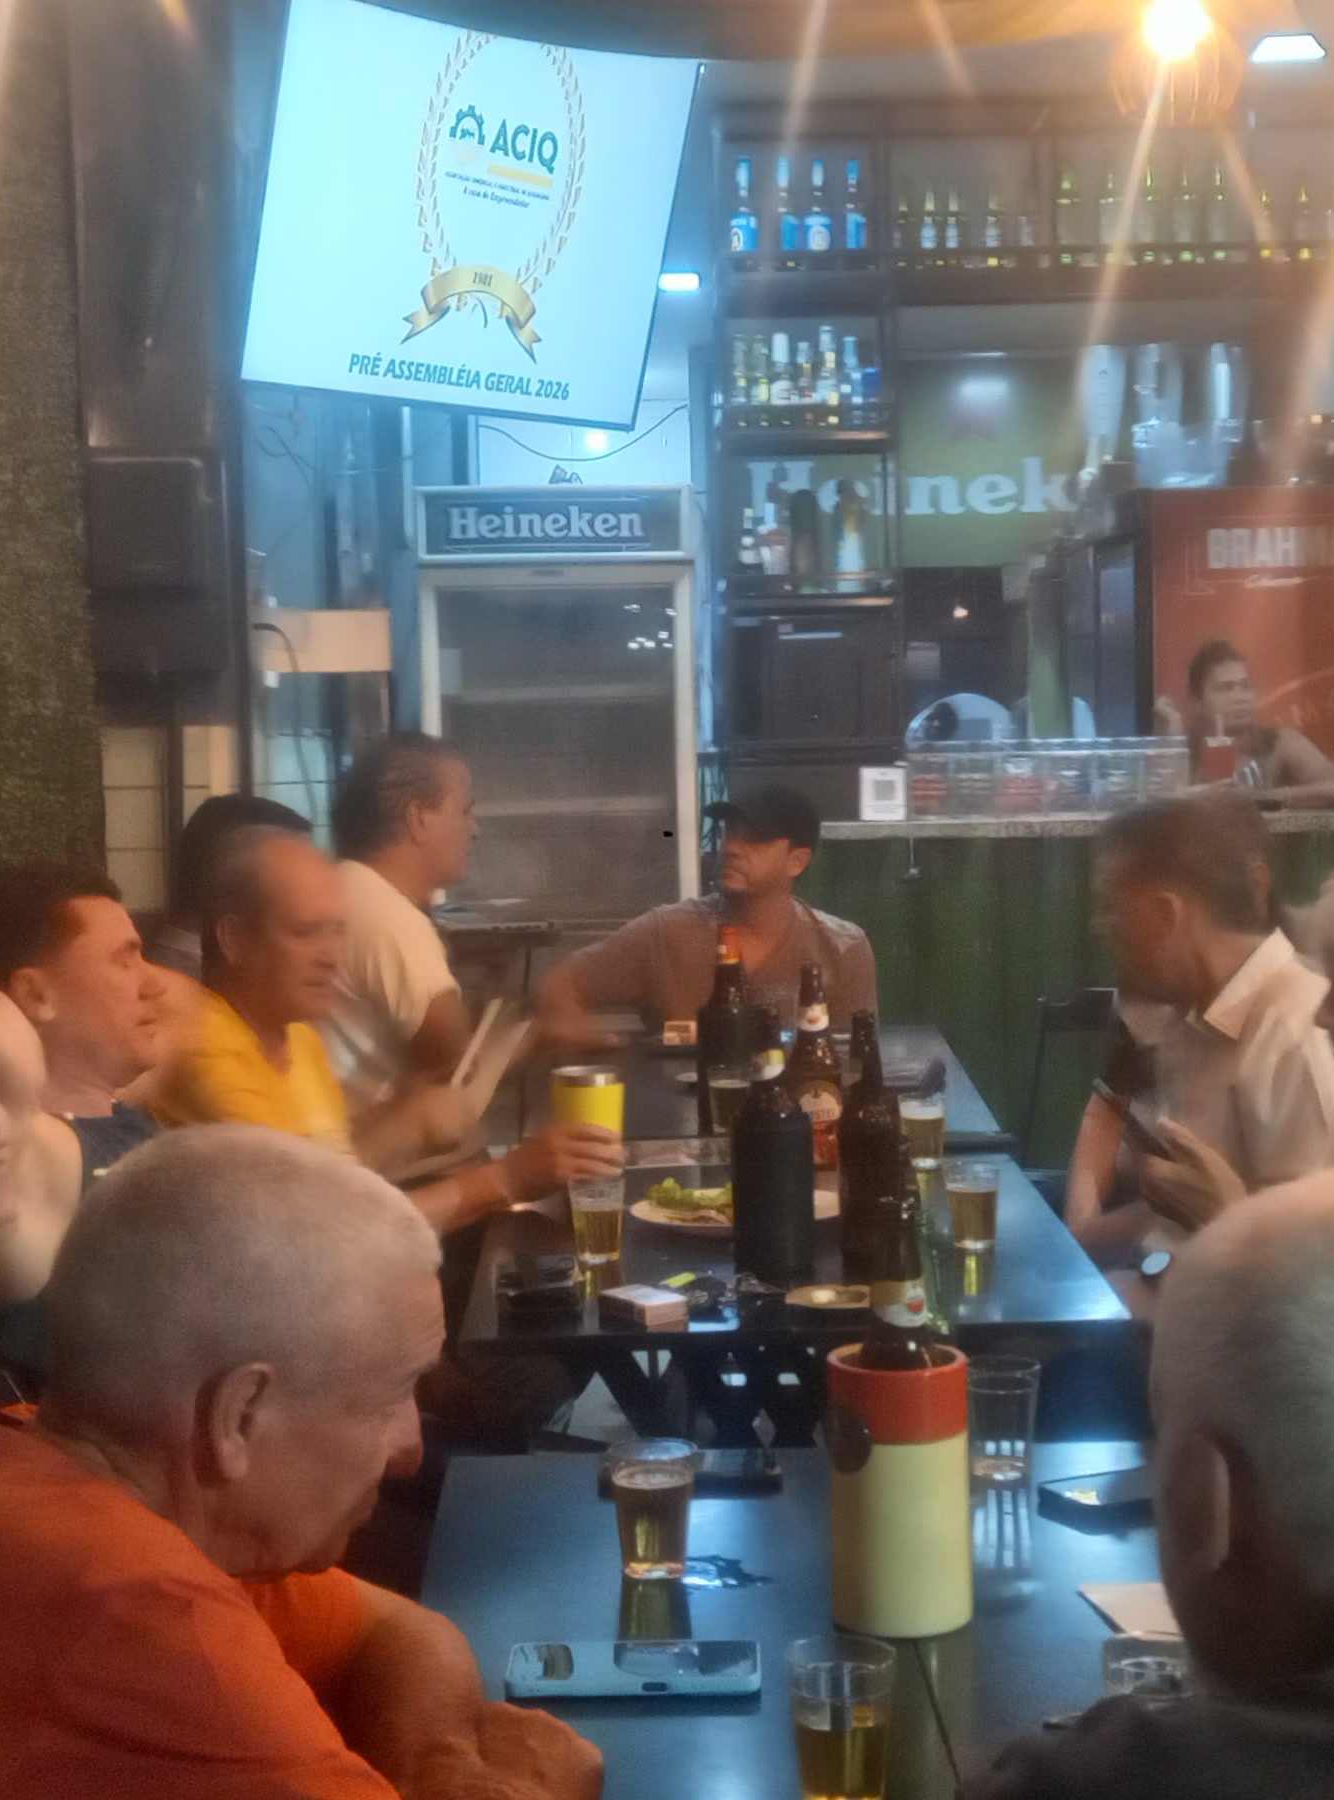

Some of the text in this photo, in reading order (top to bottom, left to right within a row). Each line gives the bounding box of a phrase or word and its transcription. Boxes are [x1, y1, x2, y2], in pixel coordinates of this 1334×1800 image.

[490, 118, 558, 175] ACIQ
[348, 352, 570, 401] PRÉ ASSEMBLÉIA GERAL 2026
[447, 505, 645, 540] Heineken
